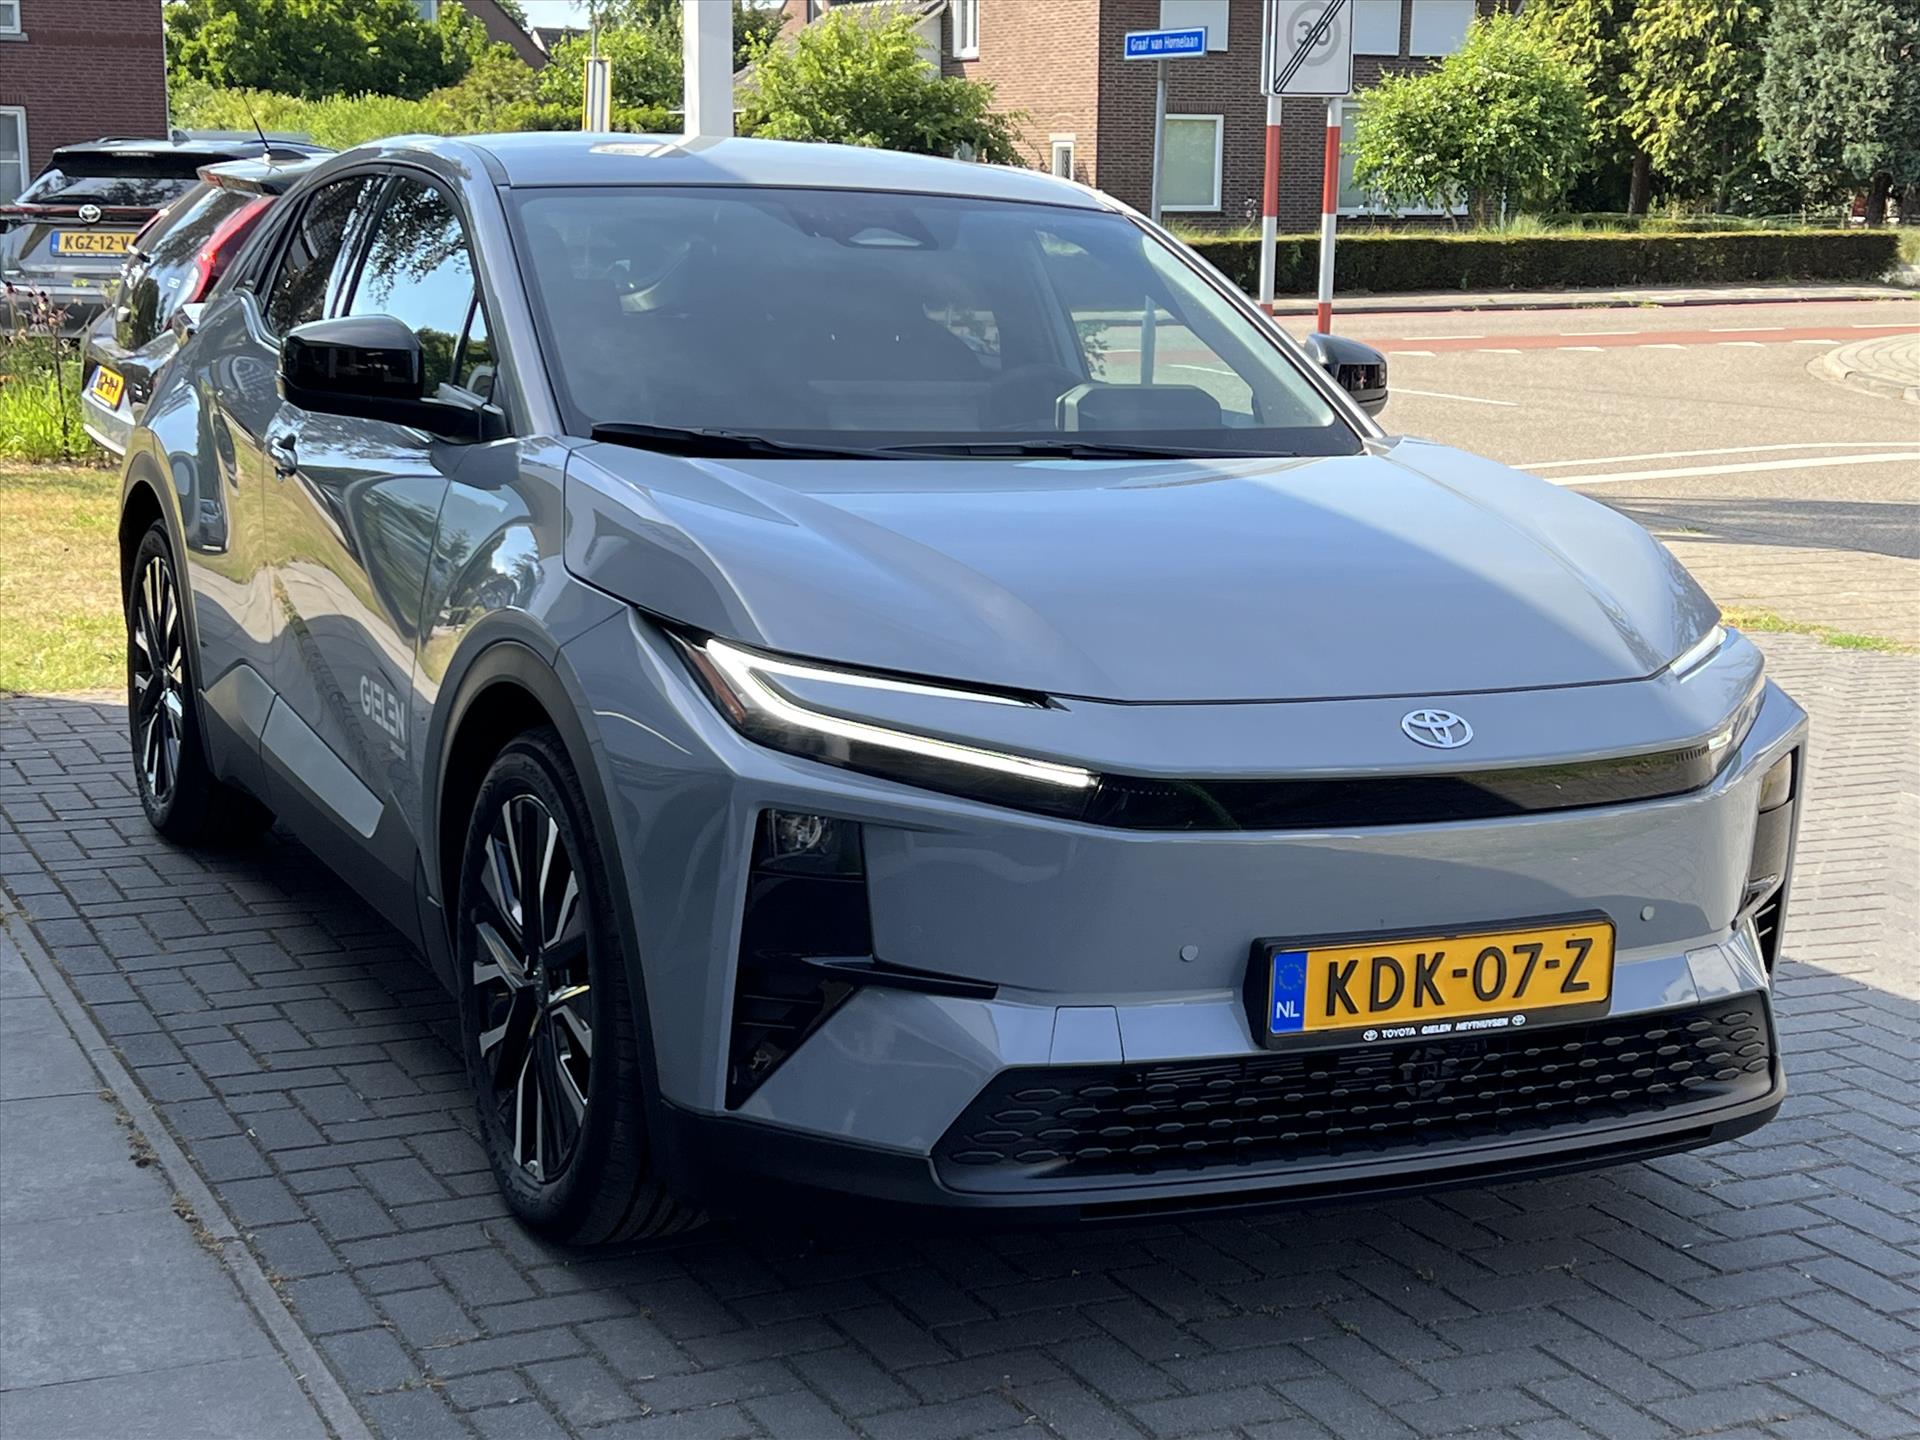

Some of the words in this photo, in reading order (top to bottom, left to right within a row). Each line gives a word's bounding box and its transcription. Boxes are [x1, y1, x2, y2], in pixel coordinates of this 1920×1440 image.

[1130, 37, 1149, 51] Graaf
[1151, 39, 1163, 50] van
[1164, 35, 1199, 49] Hornelaan
[64, 235, 131, 251] KGZ-12-V
[360, 675, 405, 742] GIELEN
[1325, 937, 1593, 1017] KDK-07-Z
[1276, 1000, 1300, 1019] NL
[1381, 1027, 1417, 1039] TOYOTA
[1421, 1023, 1452, 1035] GIELEN
[1455, 1017, 1509, 1032] HEYTHUYSEN
